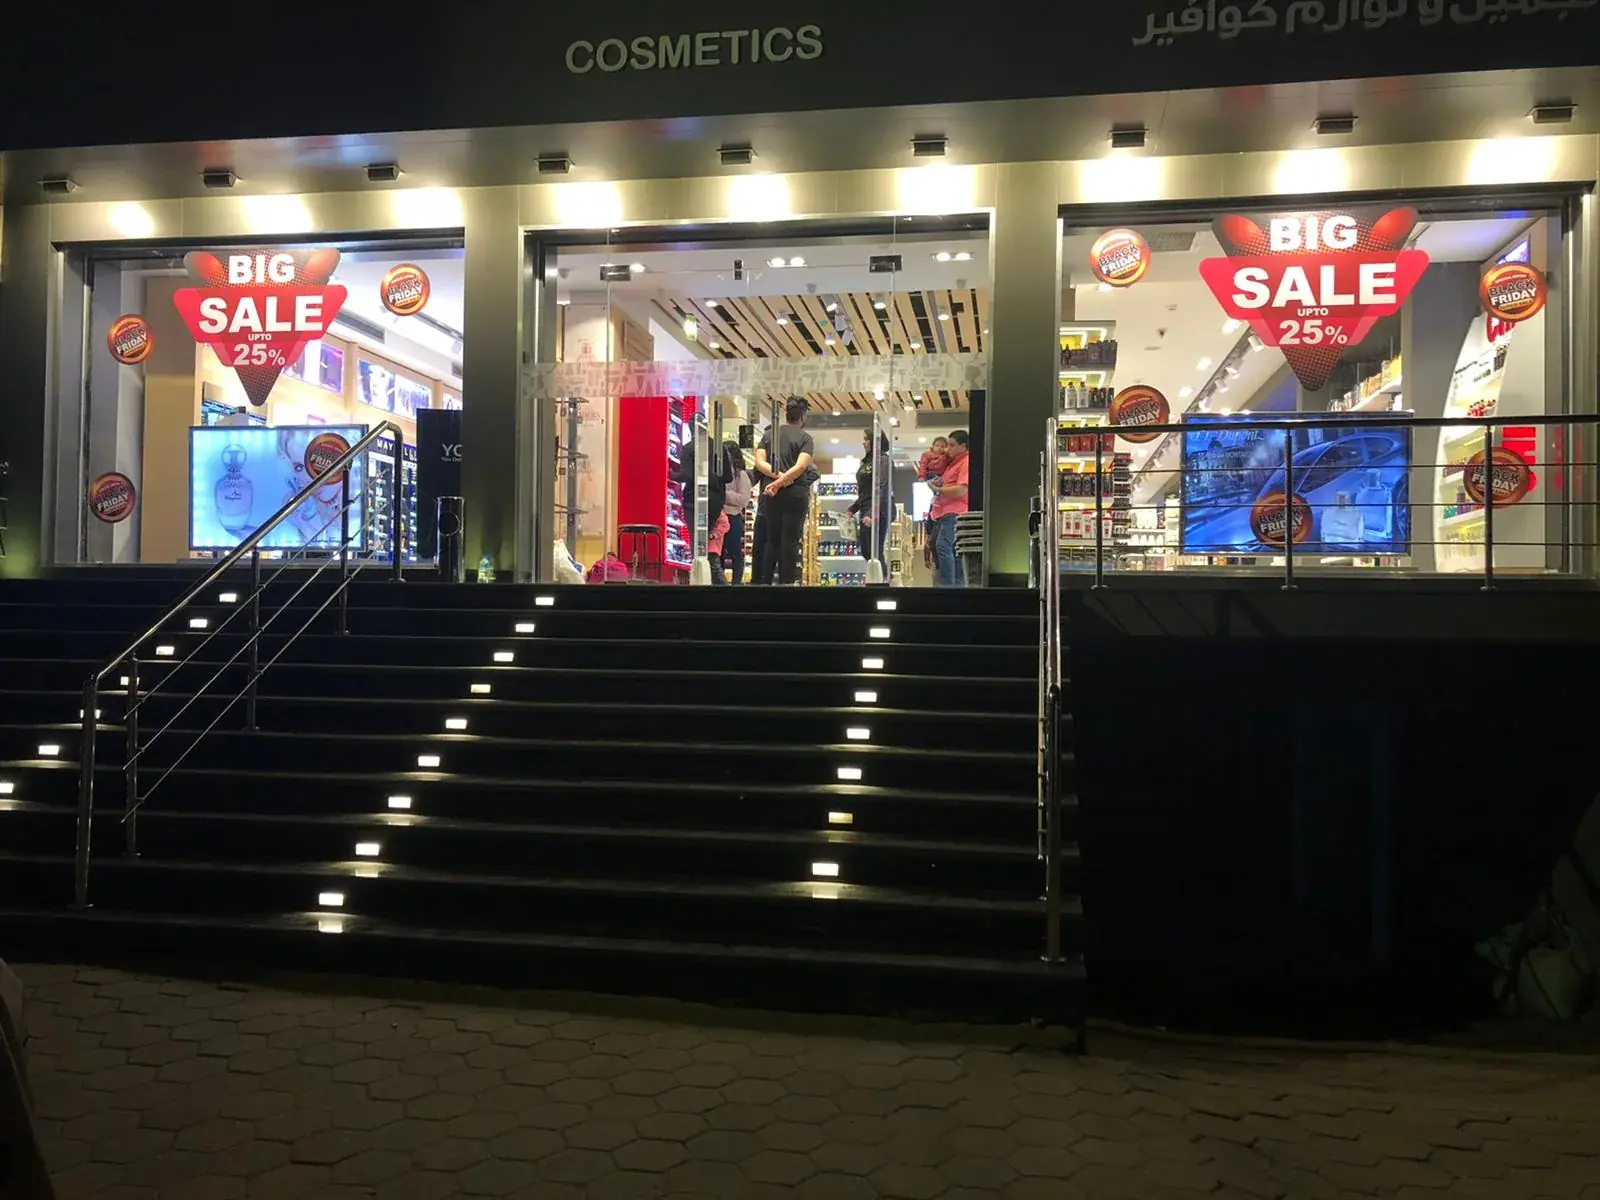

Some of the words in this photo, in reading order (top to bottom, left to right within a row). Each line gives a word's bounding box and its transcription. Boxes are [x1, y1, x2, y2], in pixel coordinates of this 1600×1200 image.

[1132, 0, 1278, 46] كوافير
[565, 24, 824, 74] COSMETICS
[1270, 215, 1358, 251] BIG
[228, 253, 296, 284] BIG
[1101, 252, 1141, 275] FRIDAY
[389, 286, 422, 304] FRIDAY
[1232, 262, 1397, 309] SALE
[1488, 278, 1537, 297] BLACK
[1490, 288, 1537, 306] FRIDAY
[198, 295, 324, 334] SALE
[1297, 308, 1329, 317] UPTO
[117, 332, 148, 354] FRIDAY
[248, 333, 272, 341] UPTO
[1278, 319, 1348, 345] 25%
[233, 343, 286, 366] 25%
[1471, 473, 1519, 492] FRDAY
[1474, 467, 1520, 484] BACK
[97, 492, 128, 511] FRIDAY
